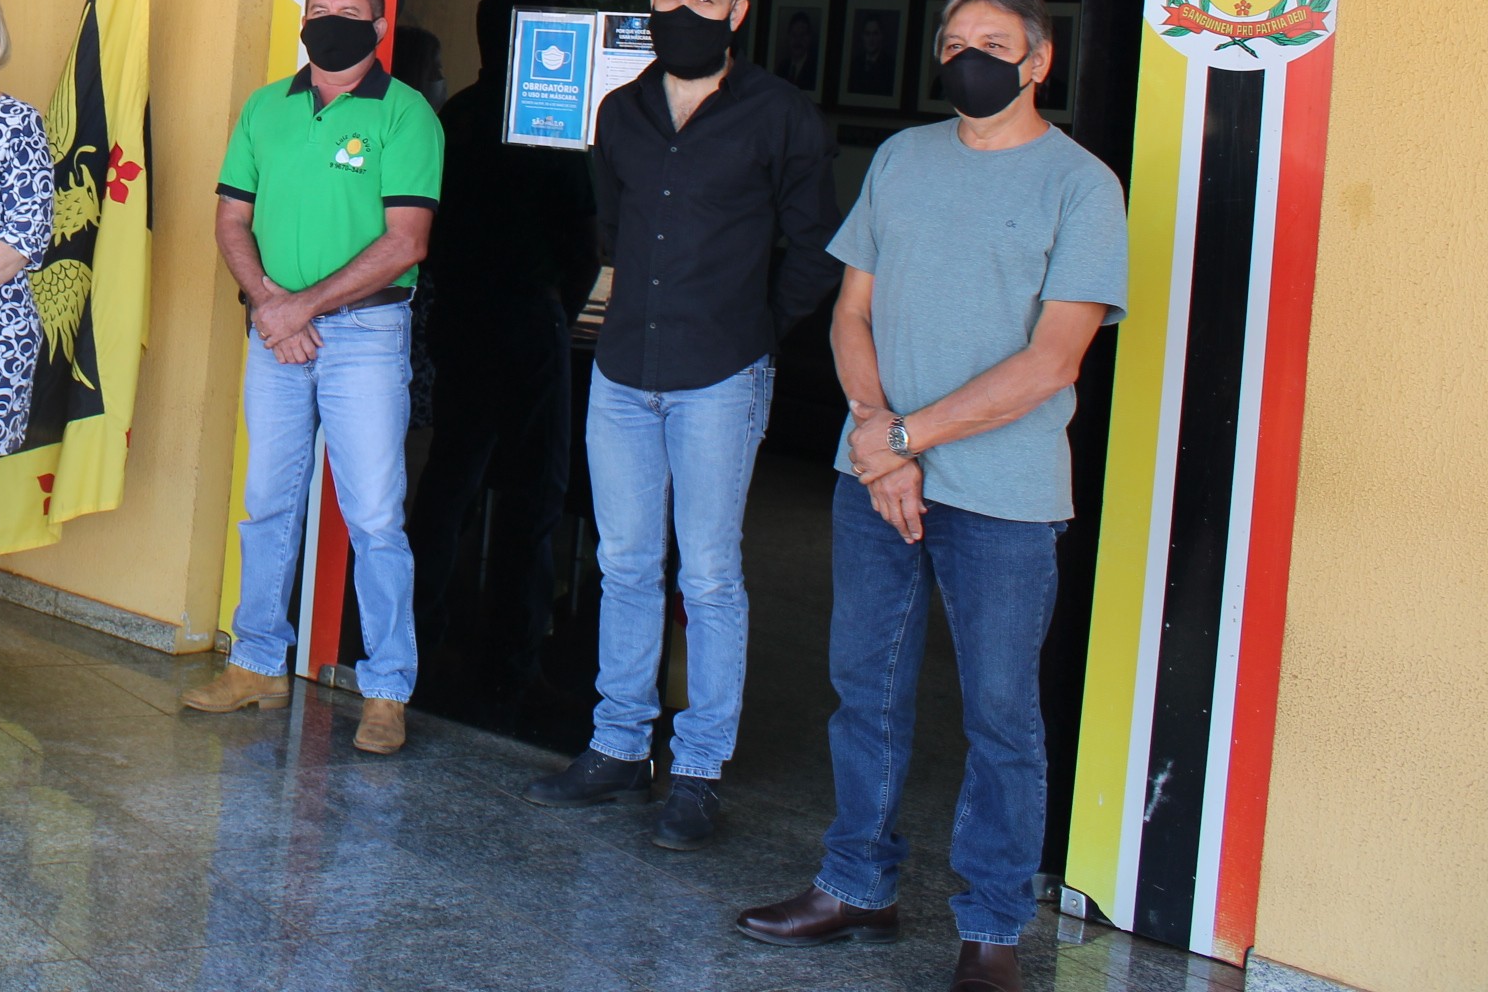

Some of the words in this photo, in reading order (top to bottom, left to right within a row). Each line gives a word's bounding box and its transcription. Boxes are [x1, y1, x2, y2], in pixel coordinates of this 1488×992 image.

[1181, 6, 1233, 35] SANGUINEM
[1236, 24, 1253, 36] PRO
[1256, 18, 1287, 34] PATRIA
[1289, 10, 1307, 25] DEDI
[522, 82, 579, 94] OBRIGATÓRIO
